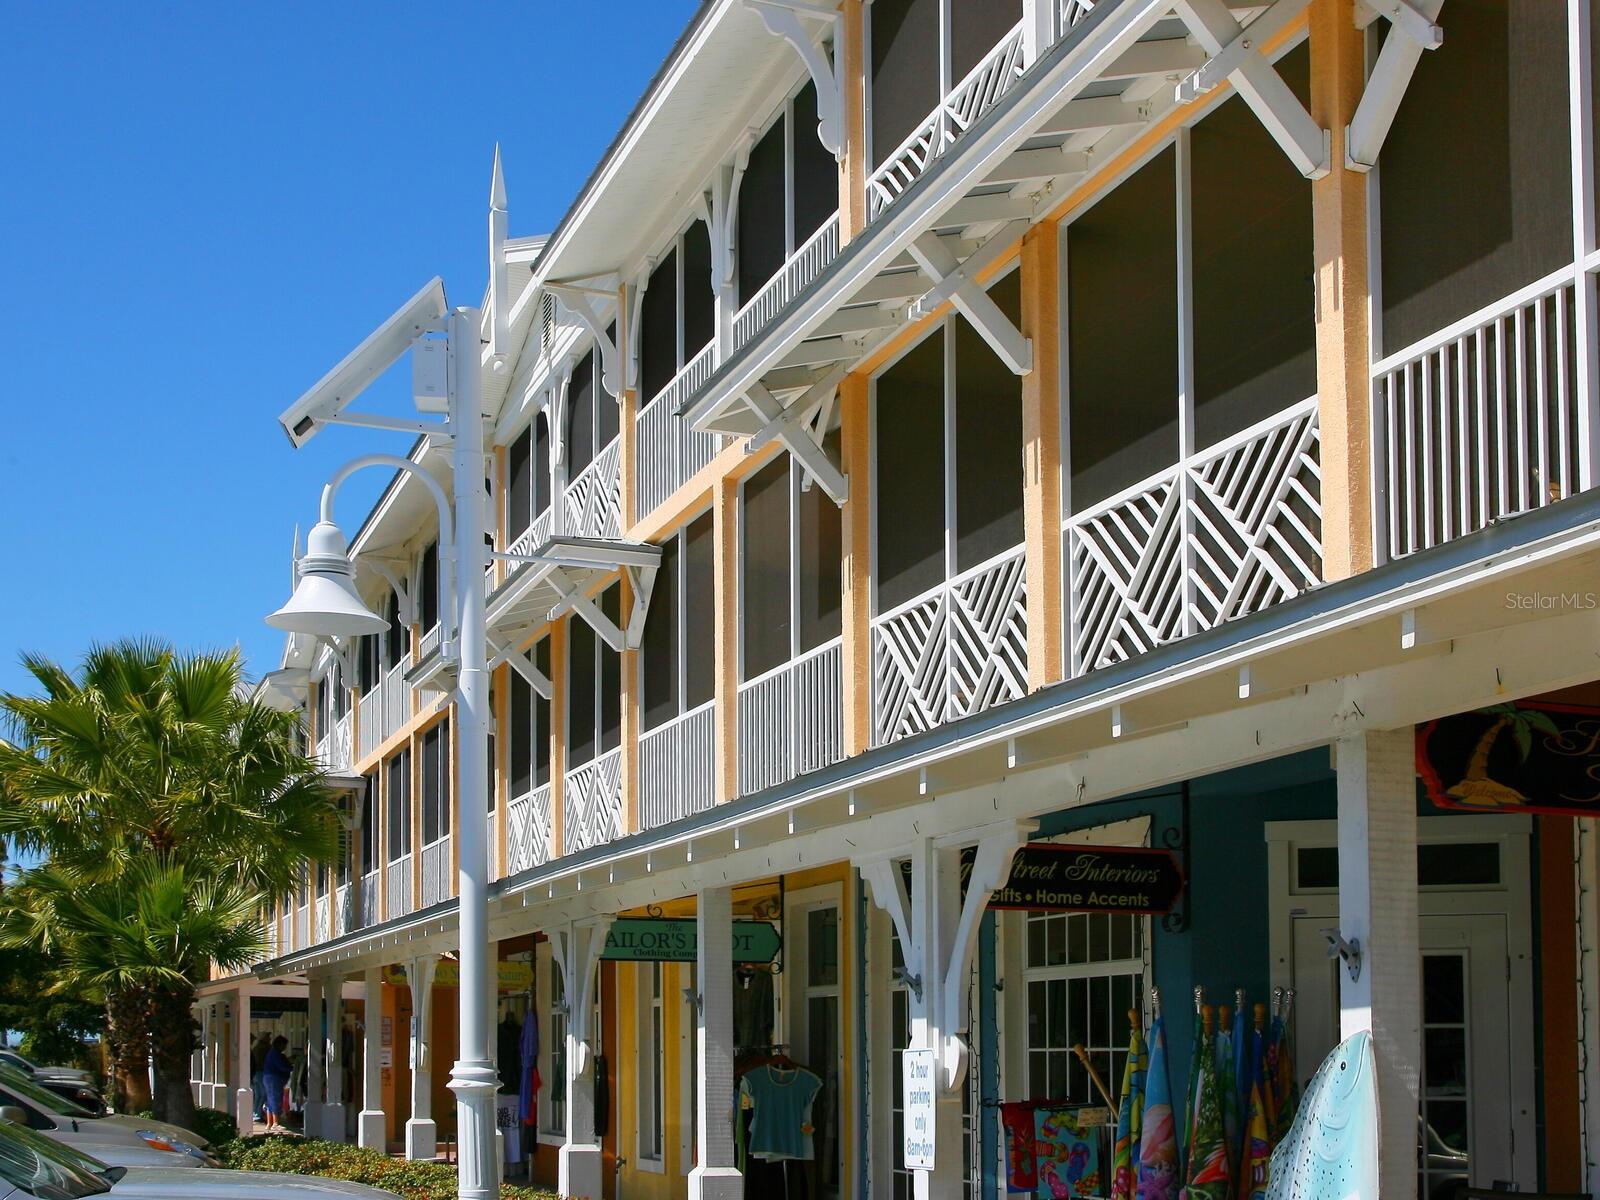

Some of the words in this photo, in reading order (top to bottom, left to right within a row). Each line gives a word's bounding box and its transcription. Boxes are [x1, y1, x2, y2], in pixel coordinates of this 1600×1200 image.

[1065, 854, 1160, 884] Interiors
[989, 888, 1022, 902] Gifts
[1036, 889, 1082, 904] Home
[1088, 892, 1150, 906] Accents
[605, 932, 686, 949] AILOR'S
[633, 950, 671, 958] Clothing
[673, 950, 697, 959] Comp
[910, 1061, 915, 1079] 2
[915, 1061, 929, 1079] hour
[909, 1086, 931, 1108] parking
[914, 1112, 927, 1133] only
[906, 1137, 933, 1160] 8am-6pm
